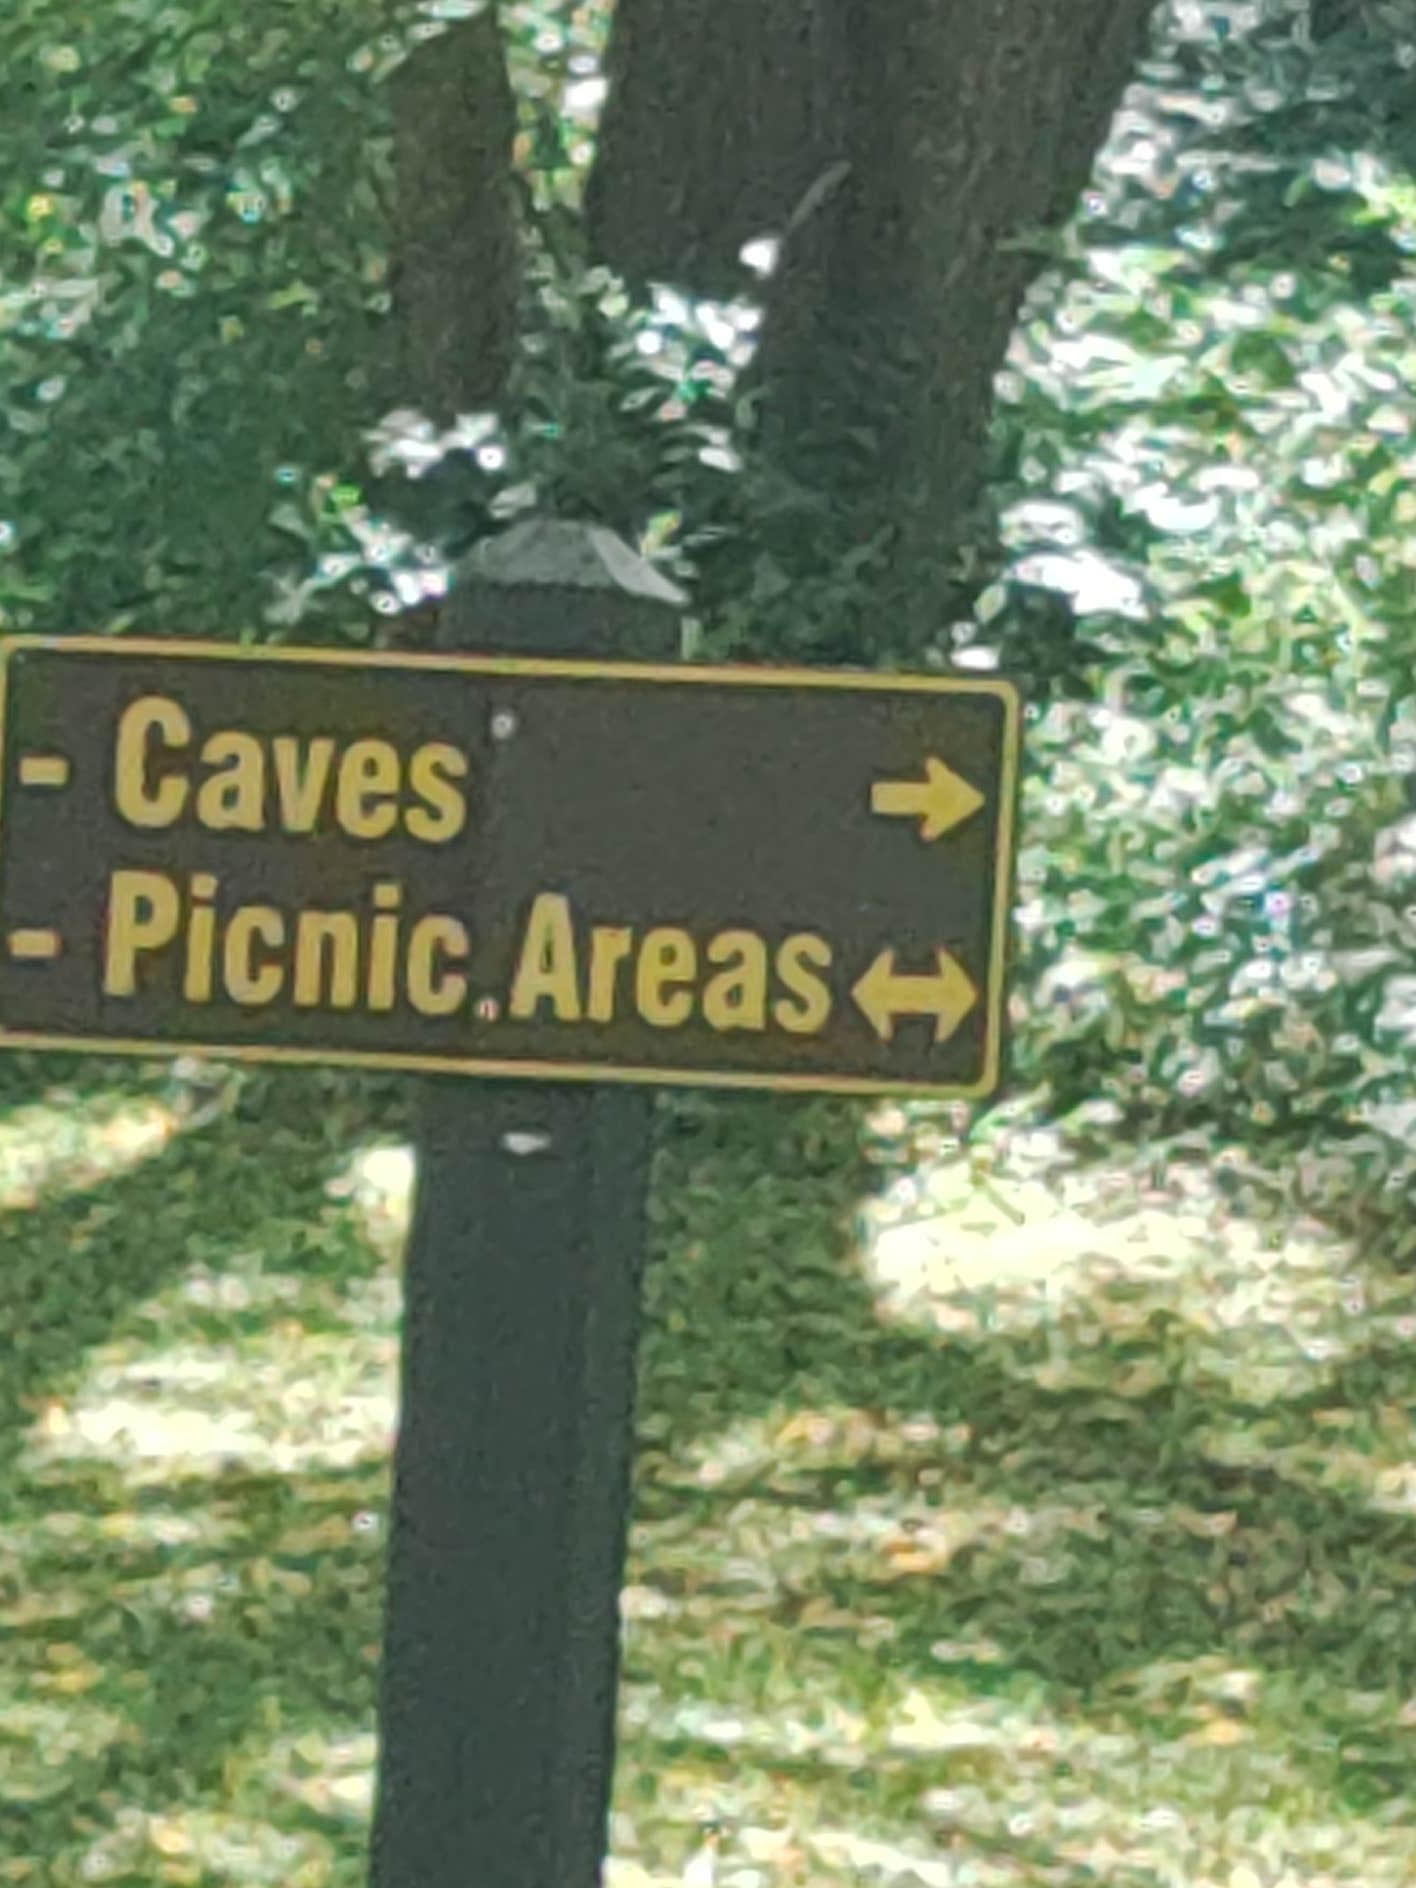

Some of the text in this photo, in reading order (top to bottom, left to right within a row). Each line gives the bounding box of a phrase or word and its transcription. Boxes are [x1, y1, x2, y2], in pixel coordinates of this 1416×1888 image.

[113, 695, 469, 844] Caves
[102, 869, 469, 1016] Picnic
[509, 891, 834, 1033] Areas
